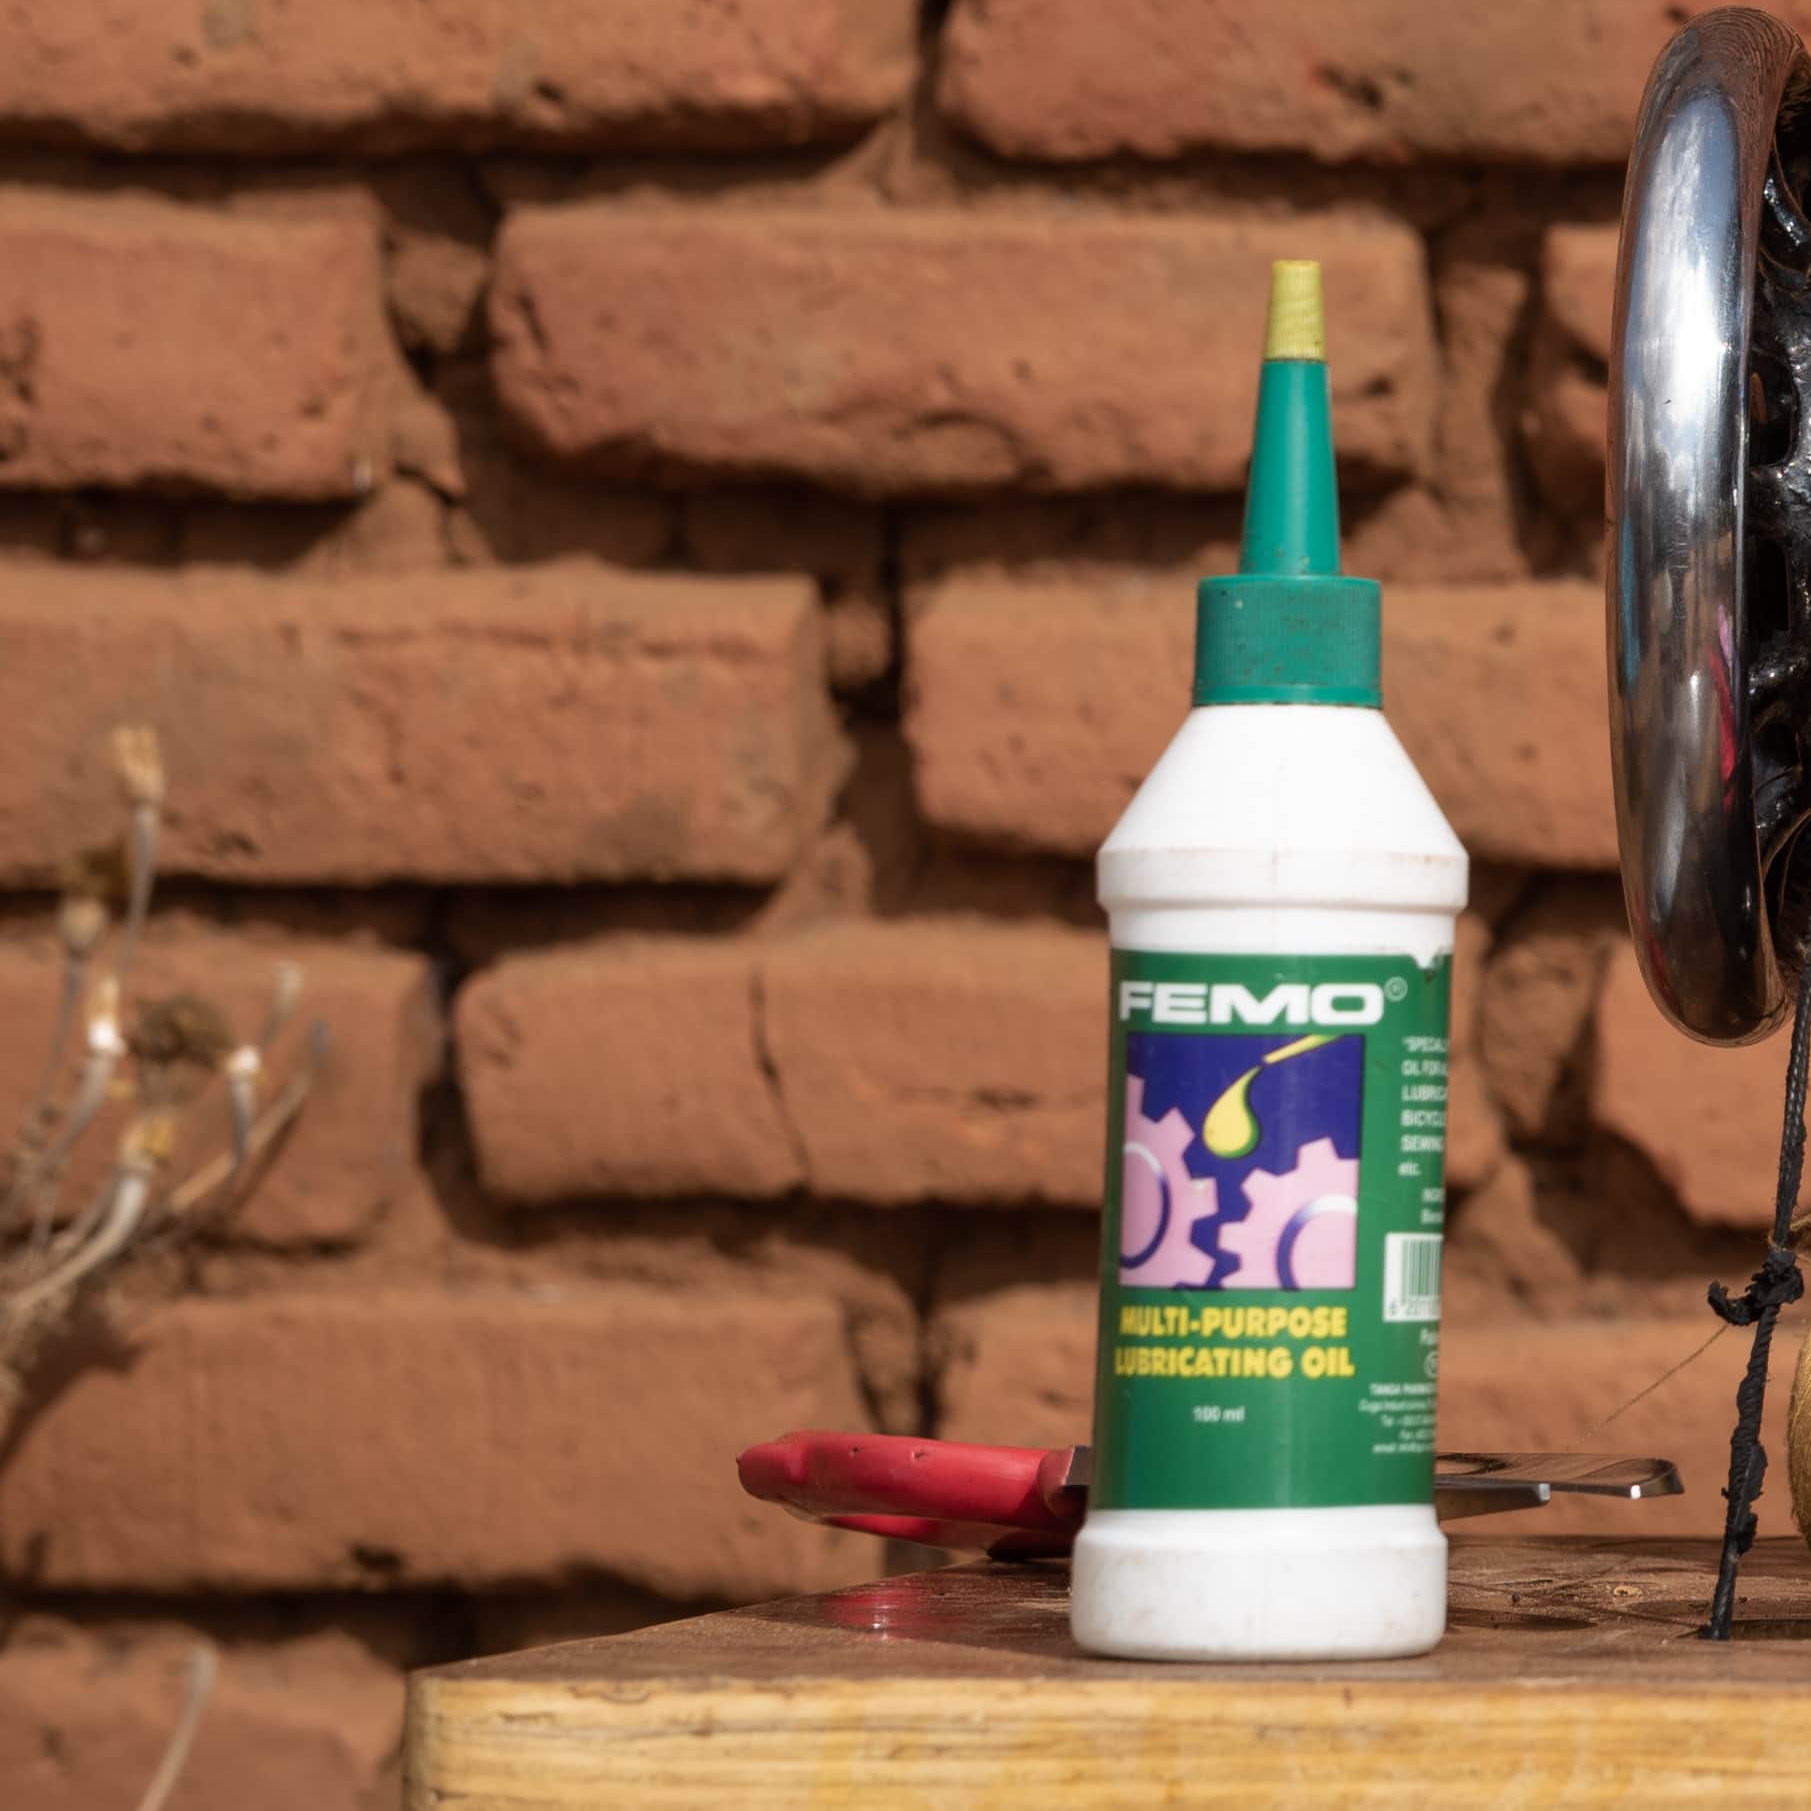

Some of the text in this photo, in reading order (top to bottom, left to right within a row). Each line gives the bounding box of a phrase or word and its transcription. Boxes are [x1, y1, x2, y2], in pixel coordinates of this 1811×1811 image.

[1119, 980, 1385, 1026] FEMO
[1119, 1305, 1348, 1338] MULTI-PURPOSE
[1114, 1345, 1356, 1379] LUBRICATING OIL
[1192, 1405, 1246, 1423] 100 ml
